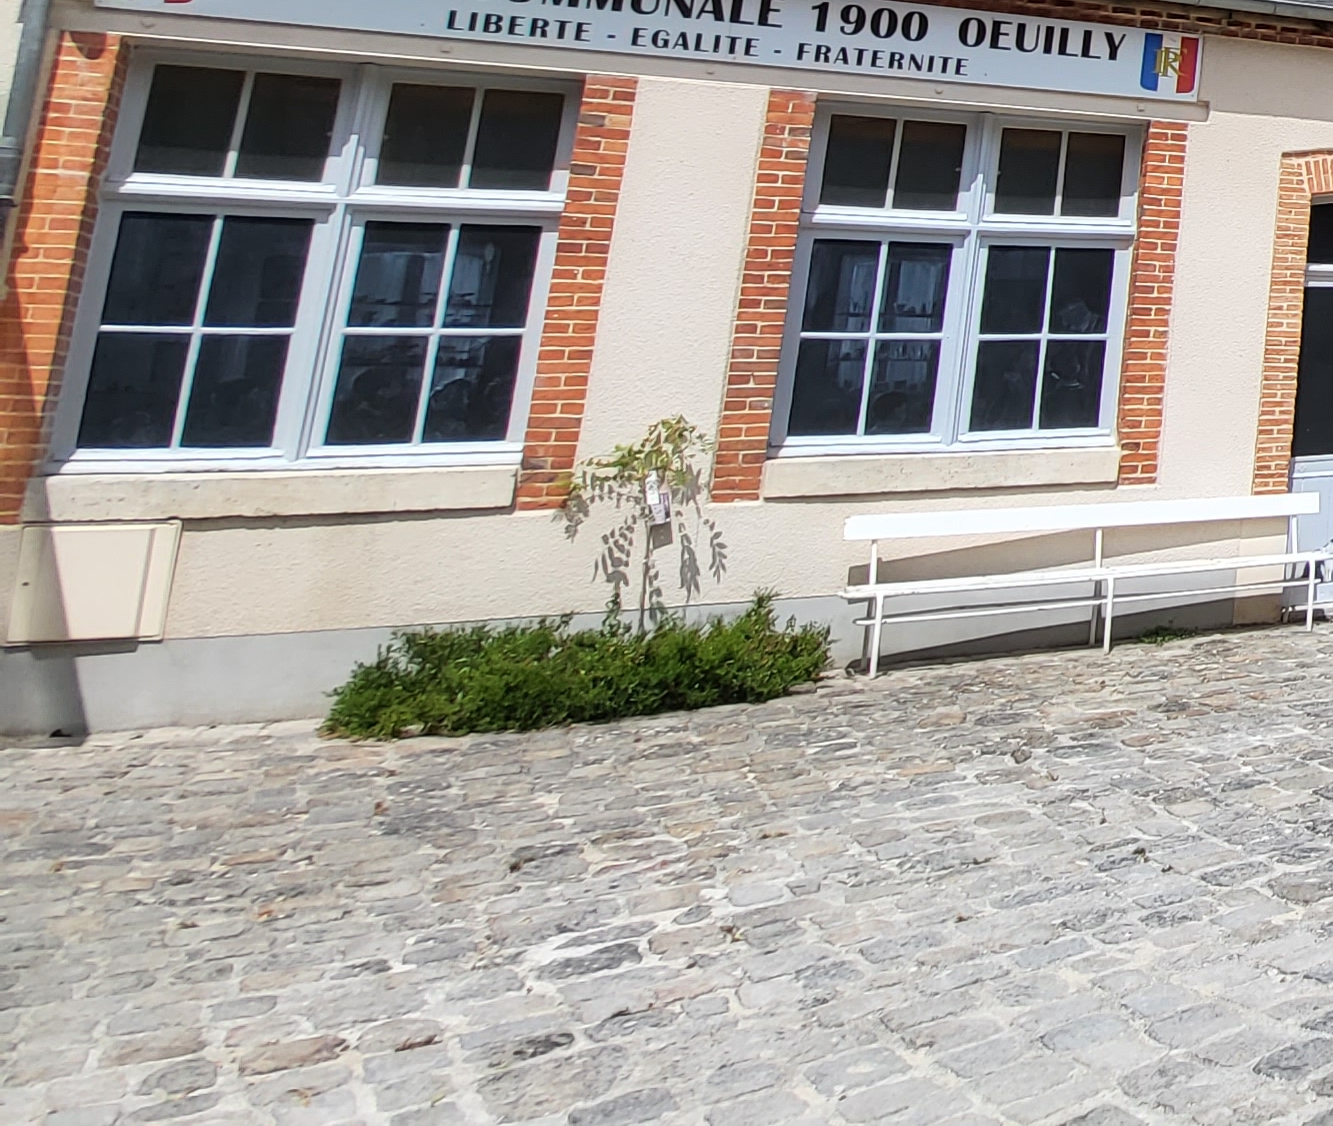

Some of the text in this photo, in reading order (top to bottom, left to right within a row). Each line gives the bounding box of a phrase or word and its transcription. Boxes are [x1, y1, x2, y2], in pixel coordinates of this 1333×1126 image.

[446, 10, 593, 42] LIBERTE
[630, 27, 761, 57] EGALITE
[797, 42, 970, 76] FRATERNITE
[811, 1, 929, 42] 1900
[958, 17, 1127, 61] OEUILLY
